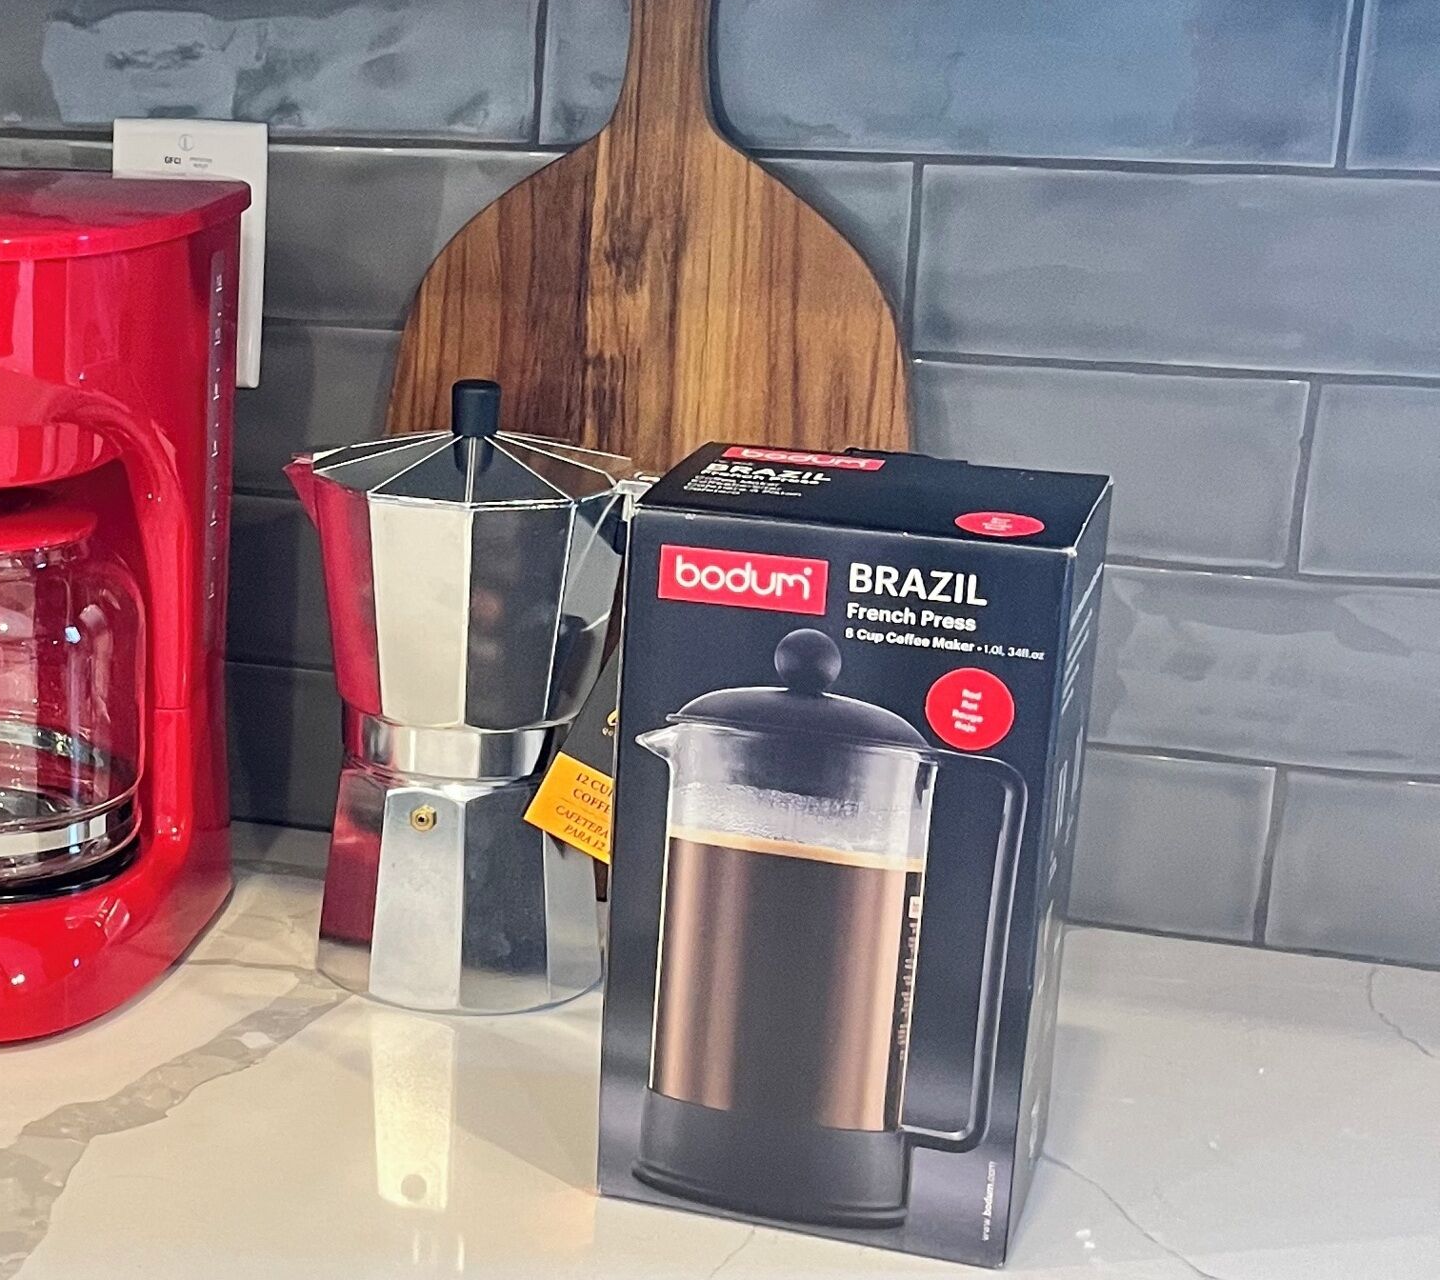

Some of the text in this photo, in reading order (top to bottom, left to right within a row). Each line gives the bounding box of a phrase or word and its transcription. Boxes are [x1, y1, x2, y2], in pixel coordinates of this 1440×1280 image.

[739, 448, 867, 469] bodum
[705, 463, 831, 481] BRAZIL
[675, 554, 813, 600] bodum
[848, 562, 988, 607] BRAZIL
[846, 602, 977, 632] French Press
[844, 627, 854, 639] 8
[856, 628, 885, 644] Cup
[885, 631, 930, 649] Coffee
[932, 636, 975, 653] Maker
[576, 772, 590, 785] 12
[555, 805, 609, 838] CAFETERA
[564, 824, 592, 844] PARA
